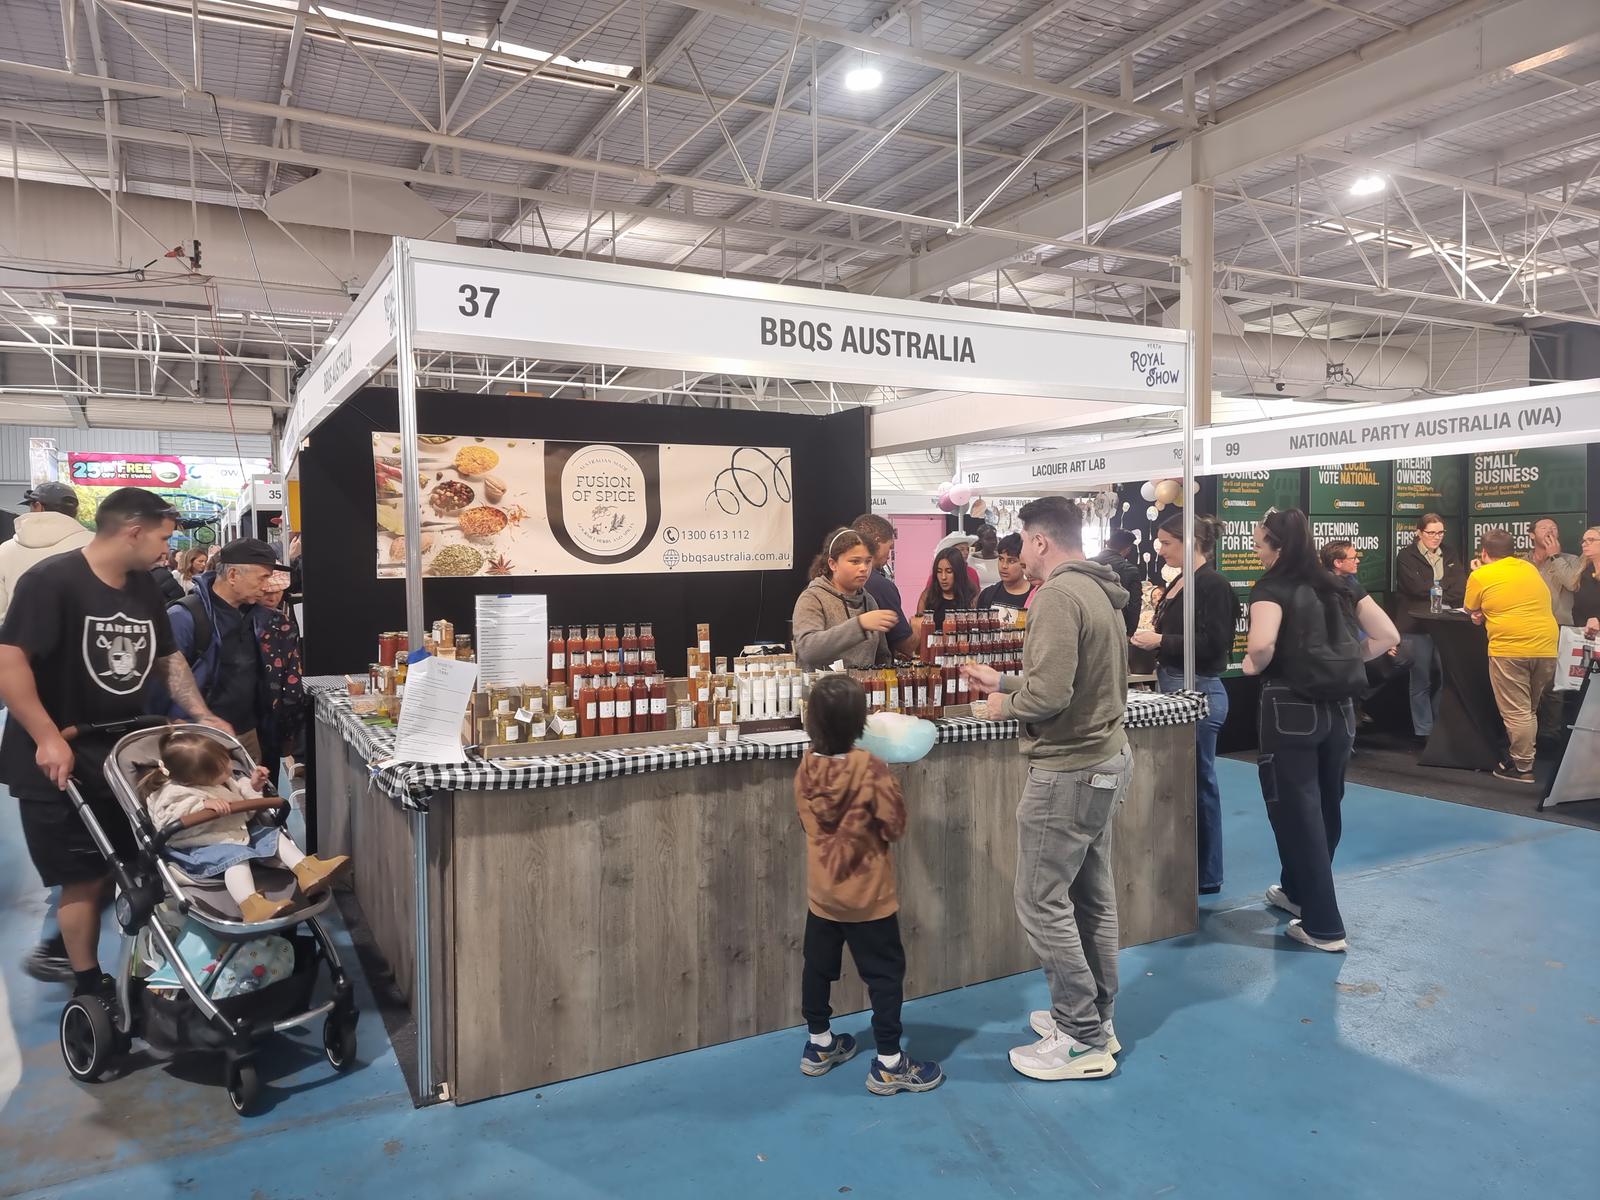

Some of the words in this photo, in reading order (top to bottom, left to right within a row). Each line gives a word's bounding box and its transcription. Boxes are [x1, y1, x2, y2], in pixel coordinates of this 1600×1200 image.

[458, 283, 500, 318] 37
[760, 316, 833, 353] BBQS
[840, 324, 976, 364] AUSTRALIA
[1130, 351, 1165, 373] ROYAL
[1146, 367, 1180, 387] SHOW
[1289, 429, 1357, 451] NATIONAL
[1361, 422, 1410, 443] PARTY
[1414, 411, 1511, 438] AUSTRALIA
[1517, 406, 1562, 431] (WA)
[1225, 442, 1240, 456] 99
[1032, 463, 1067, 477] LACQUER
[1070, 460, 1086, 473] ART
[1088, 458, 1106, 471] LAB
[1396, 456, 1433, 470] FIREARM
[1475, 454, 1517, 470] SMALL
[577, 476, 631, 488] FUSION
[967, 473, 979, 483] 102
[1318, 471, 1339, 485] VOTE
[1340, 472, 1380, 486] NATIONAL.
[1396, 469, 1432, 485] OWNERS
[1474, 466, 1539, 485] BUSINESS
[268, 490, 281, 499] 35
[572, 490, 591, 501] OF
[596, 491, 636, 502] SPICE
[682, 530, 706, 540] 1300
[709, 530, 728, 540] 613
[733, 530, 750, 540] 112
[1313, 521, 1359, 536] EXTENDING
[1221, 535, 1240, 550] FOR
[1351, 536, 1379, 550] HOURS
[1396, 531, 1417, 545] FIRS
[681, 551, 790, 565] bbqsaustralia.com.au
